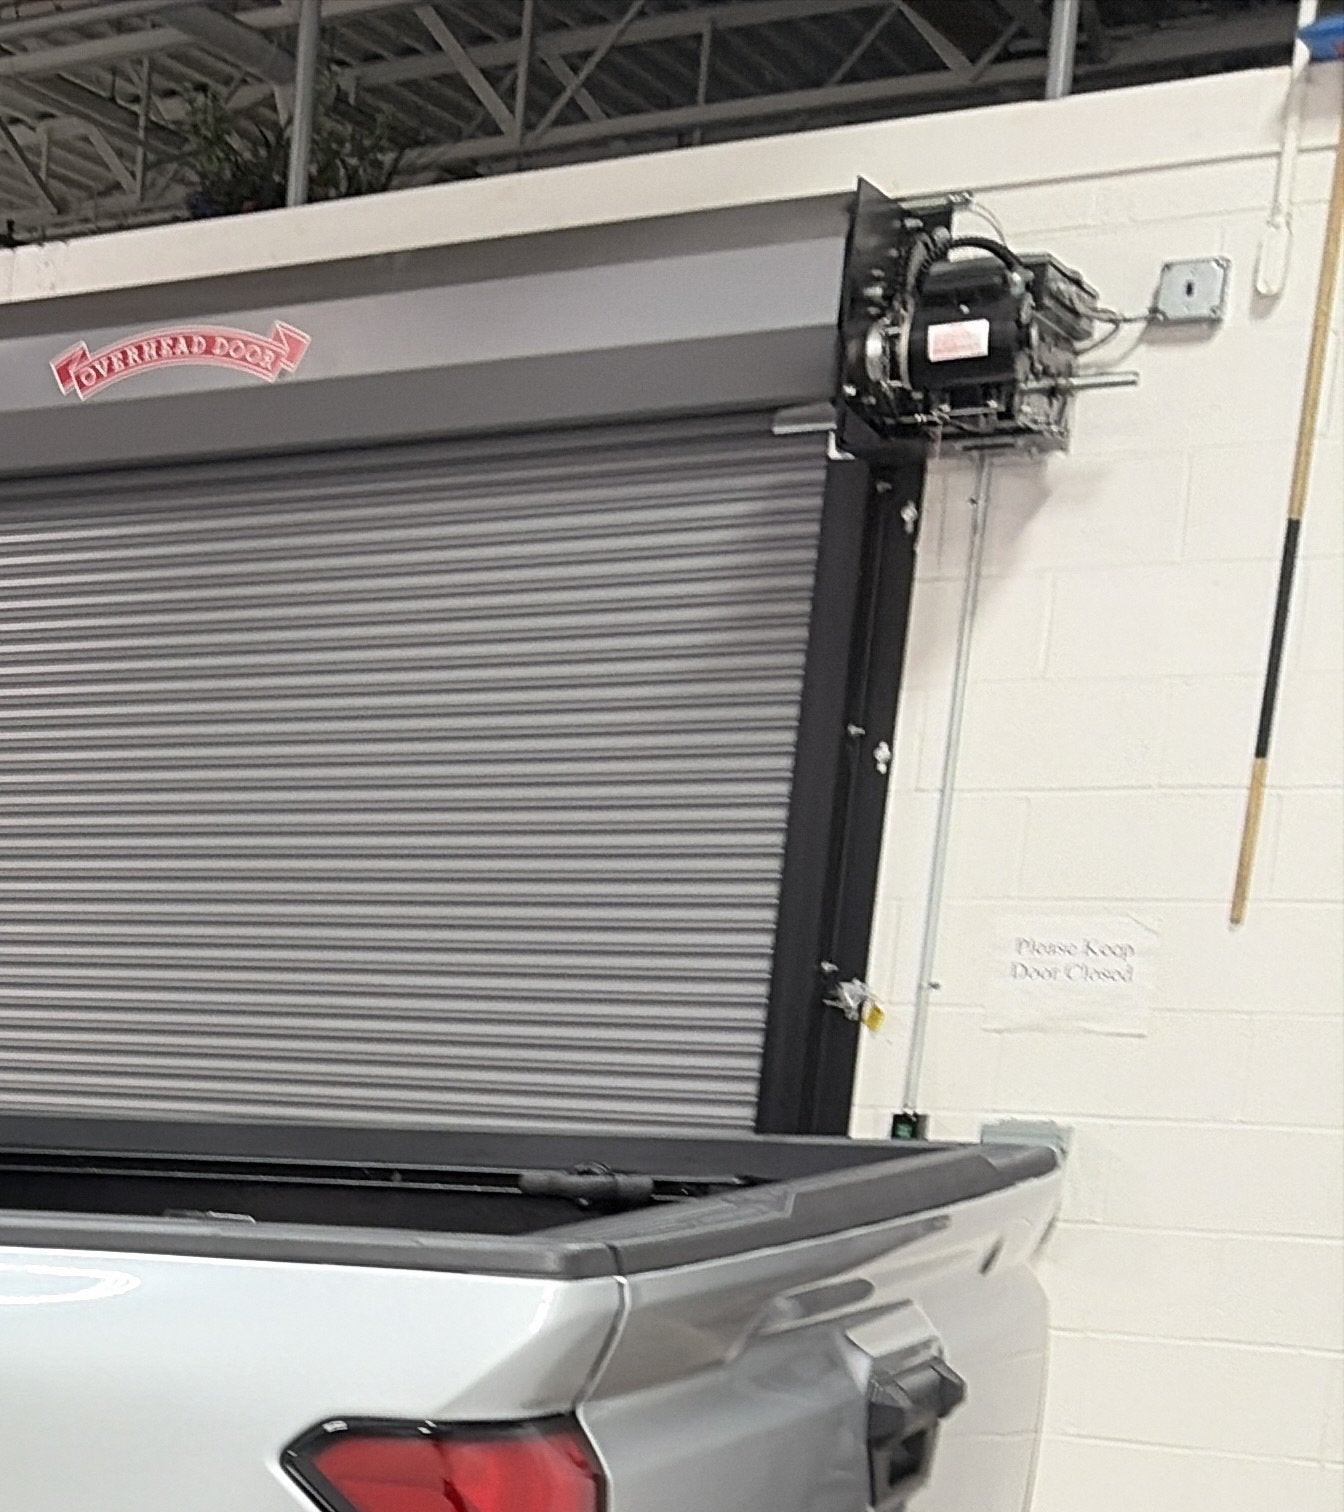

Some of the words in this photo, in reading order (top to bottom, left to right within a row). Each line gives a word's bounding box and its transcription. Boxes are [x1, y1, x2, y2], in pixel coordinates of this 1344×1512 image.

[80, 334, 206, 388] OVERHEAD
[215, 337, 277, 370] DOOR
[1015, 936, 1078, 956] Please
[1083, 937, 1136, 961] Keep
[1010, 961, 1059, 981] Door
[1063, 963, 1135, 983] Closed
